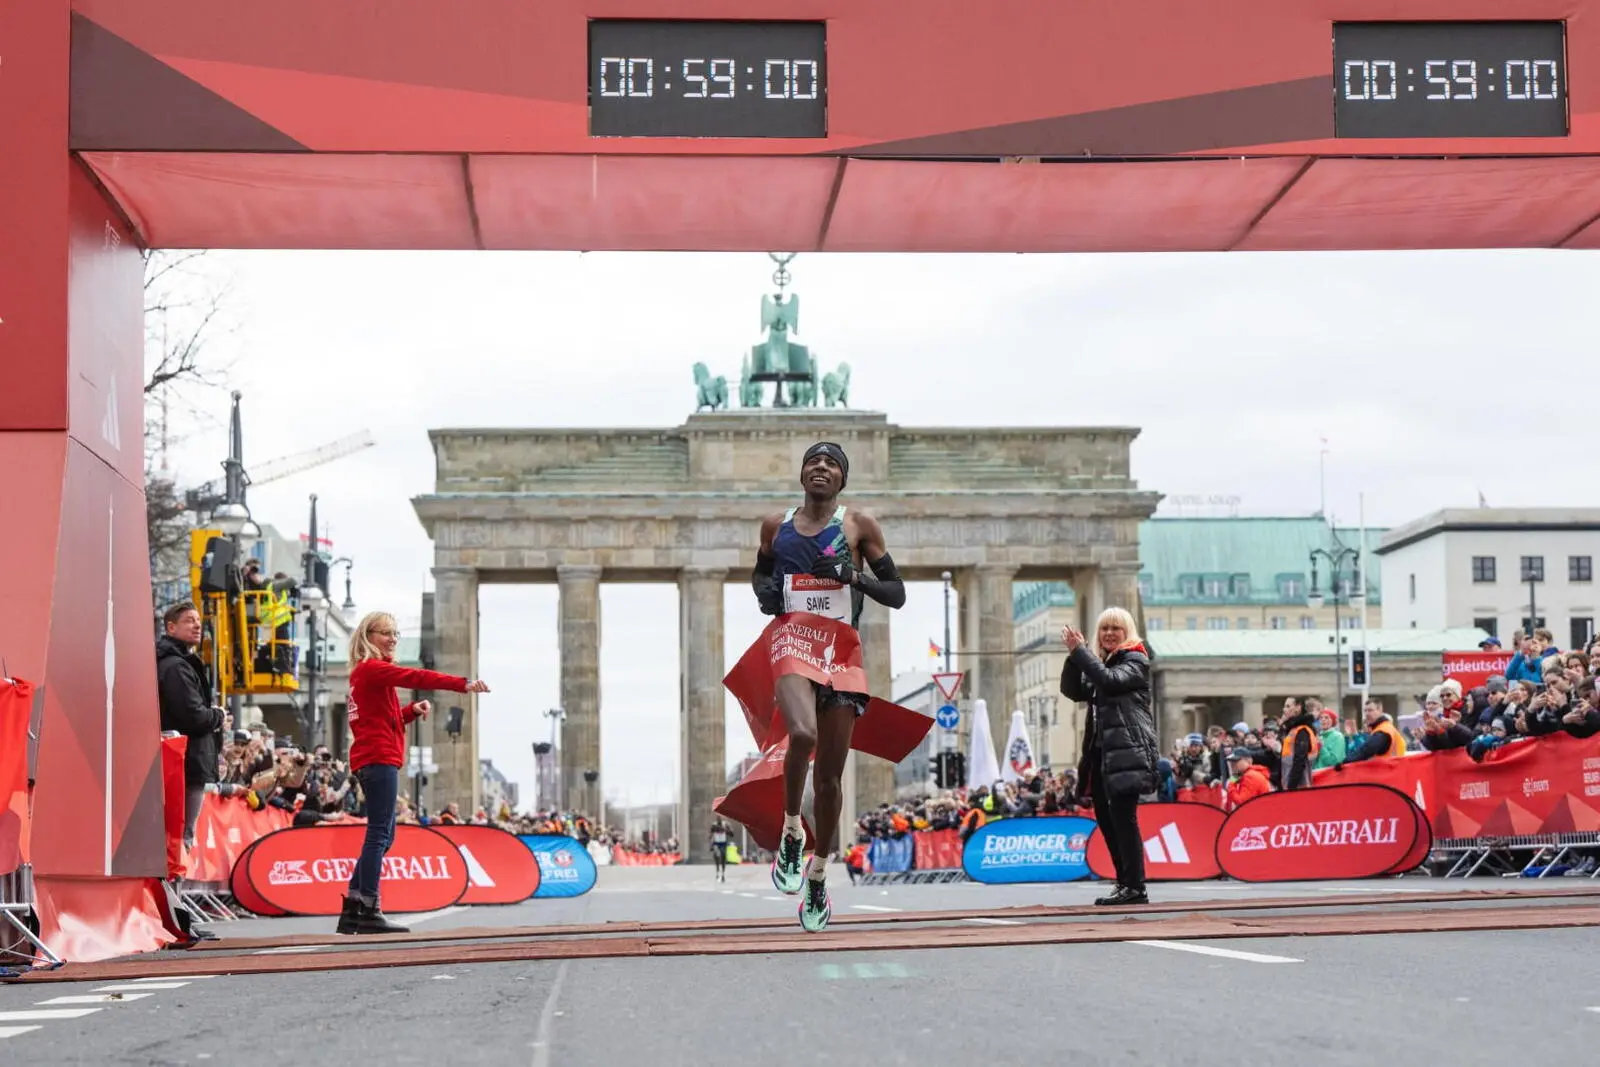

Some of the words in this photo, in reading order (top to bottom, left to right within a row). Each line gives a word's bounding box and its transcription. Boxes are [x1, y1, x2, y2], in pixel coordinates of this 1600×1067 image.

[599, 57, 818, 100] 00:59:00
[1343, 59, 1558, 100] 00:59:00
[806, 596, 831, 611] SAWE
[770, 634, 813, 653] BERLINER
[983, 833, 1067, 852] ERDINGER
[1269, 817, 1400, 849] GENERALI
[311, 855, 453, 883] GEERALI
